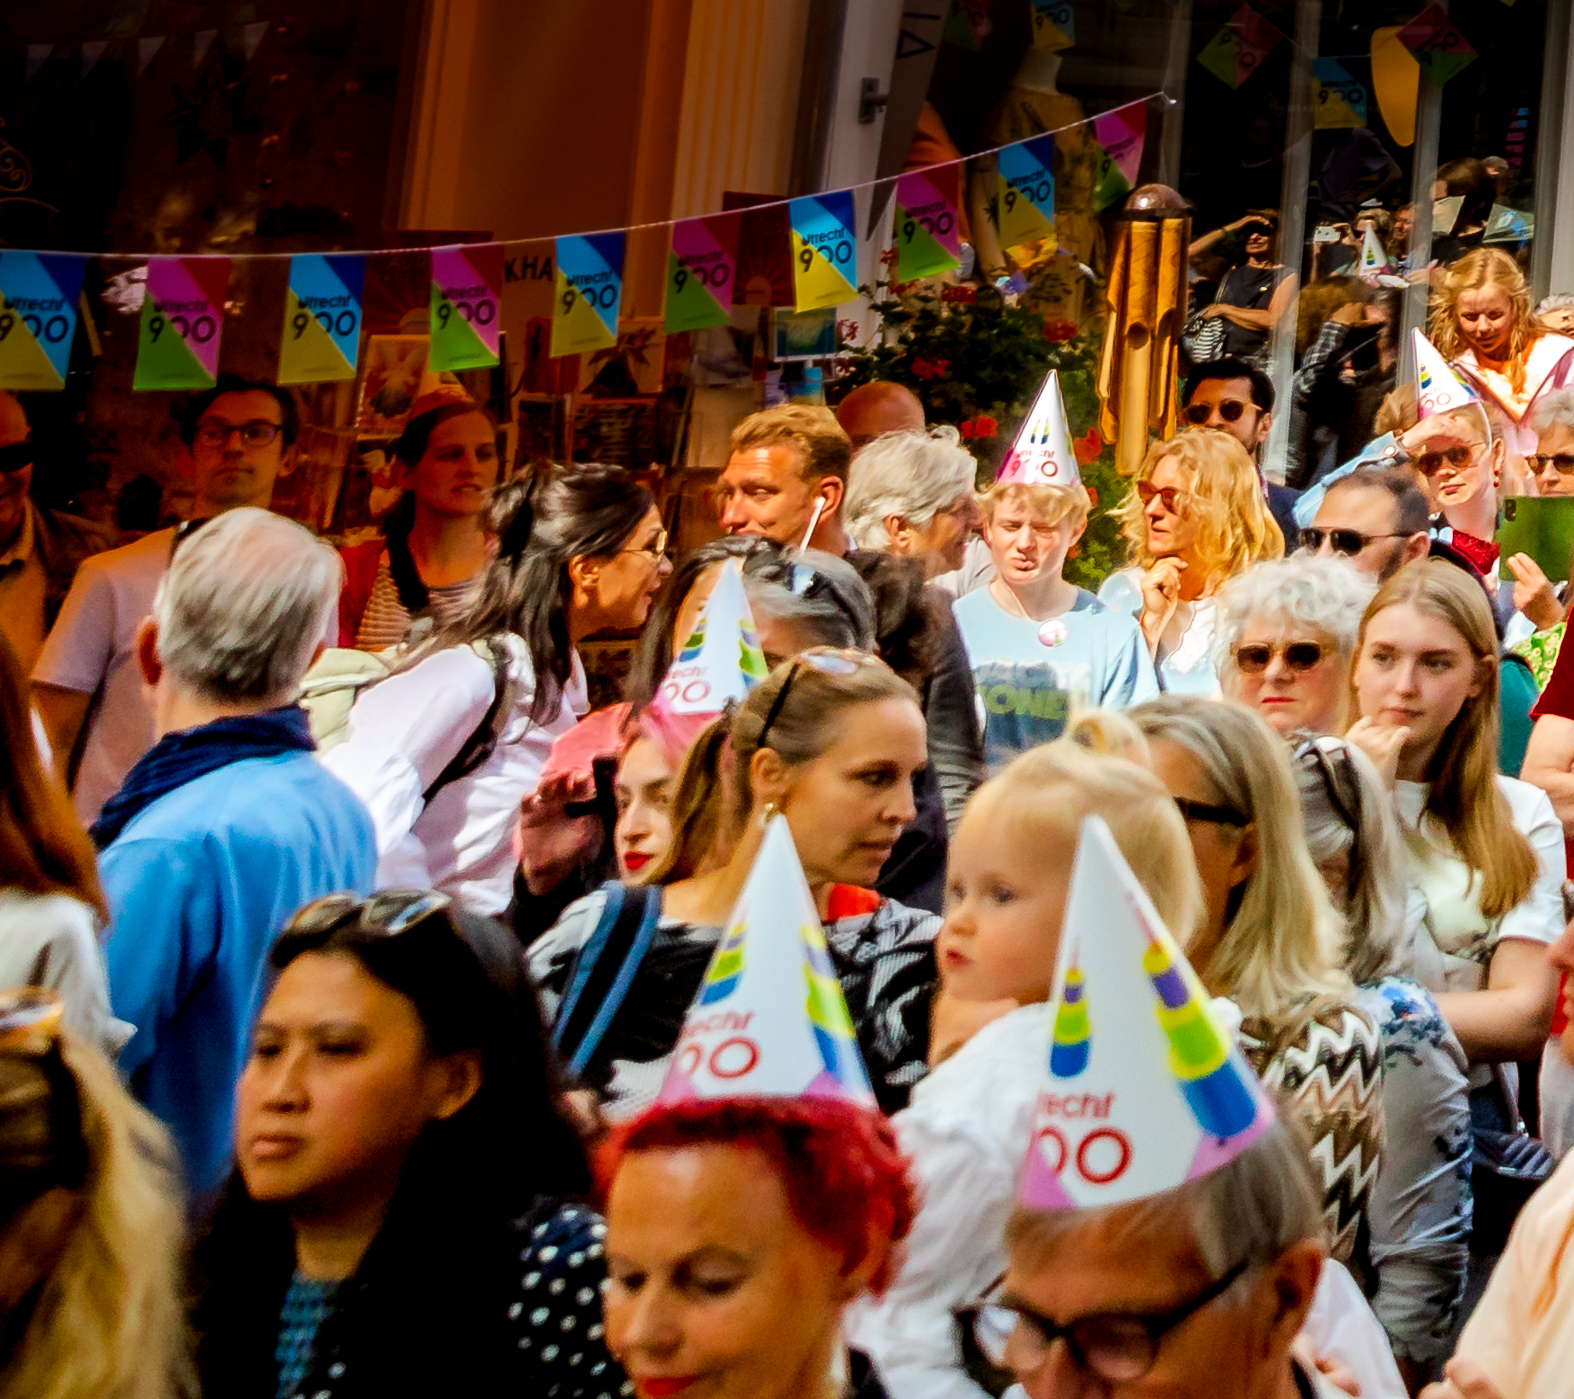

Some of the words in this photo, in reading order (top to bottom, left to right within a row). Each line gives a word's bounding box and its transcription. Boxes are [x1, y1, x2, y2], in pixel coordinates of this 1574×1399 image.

[1004, 181, 1050, 214] 900
[802, 226, 845, 246] Utrecht
[902, 211, 954, 246] 900
[798, 239, 852, 273] 900
[673, 262, 730, 294] 900
[436, 298, 497, 330] 900
[561, 283, 618, 316] 900
[148, 314, 216, 344] 900
[292, 309, 357, 340] 900
[1422, 392, 1452, 409] 00
[663, 680, 711, 703] 00
[680, 1036, 759, 1080] 00
[1038, 1125, 1134, 1186] 00
